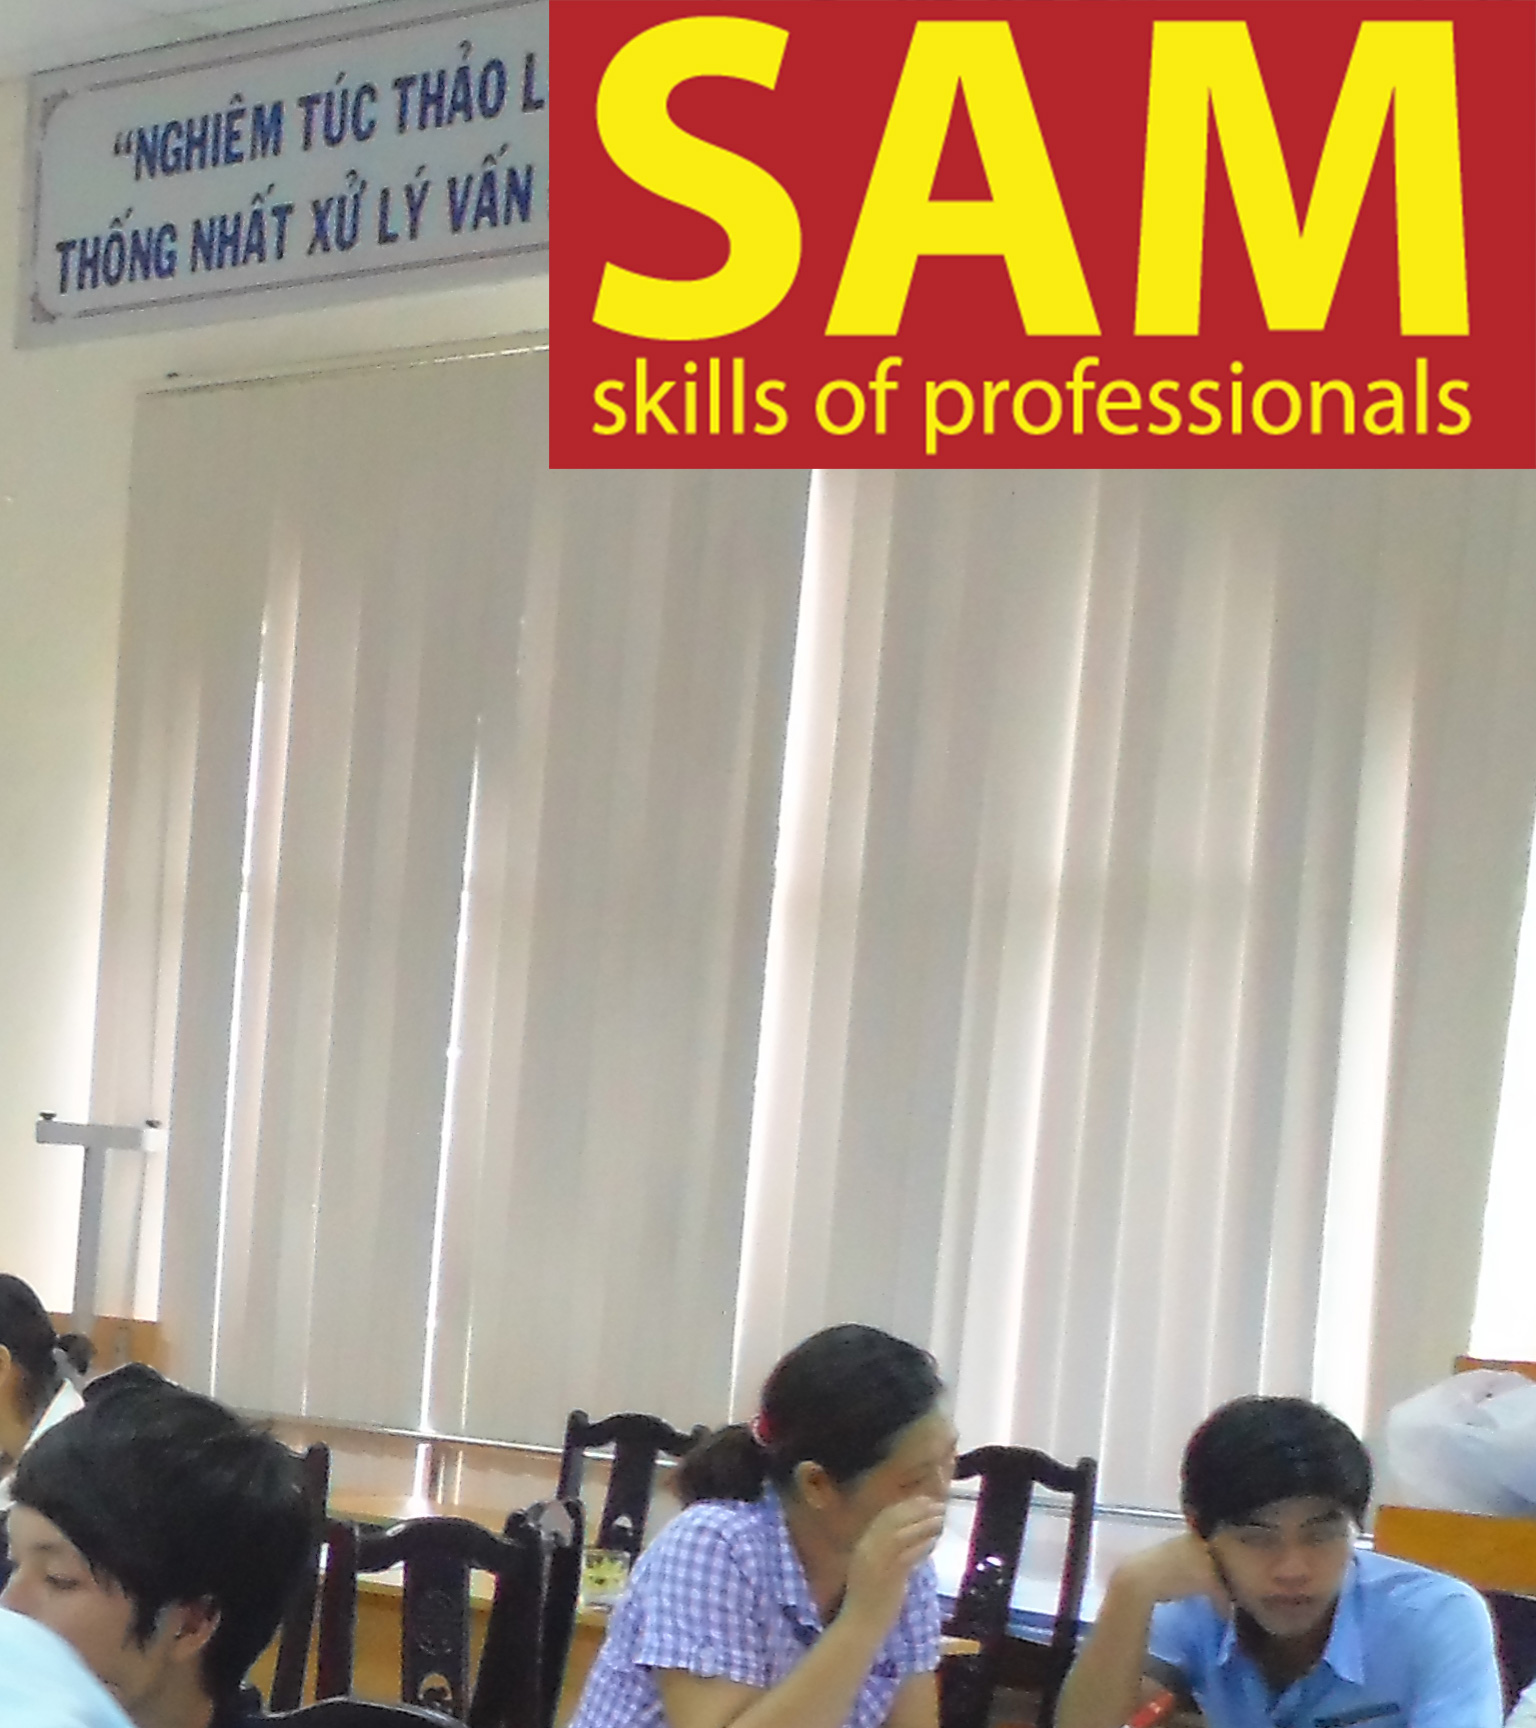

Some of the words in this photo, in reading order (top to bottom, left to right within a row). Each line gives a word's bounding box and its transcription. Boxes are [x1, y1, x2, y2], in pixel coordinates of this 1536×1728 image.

[297, 71, 377, 151] TÚC
[393, 40, 506, 134] THẢO
[56, 207, 177, 293] THỐNG
[190, 183, 294, 272] NHẤT
[307, 169, 367, 255] XỬ
[378, 165, 430, 244] LÝ
[448, 143, 533, 234] VẤN
